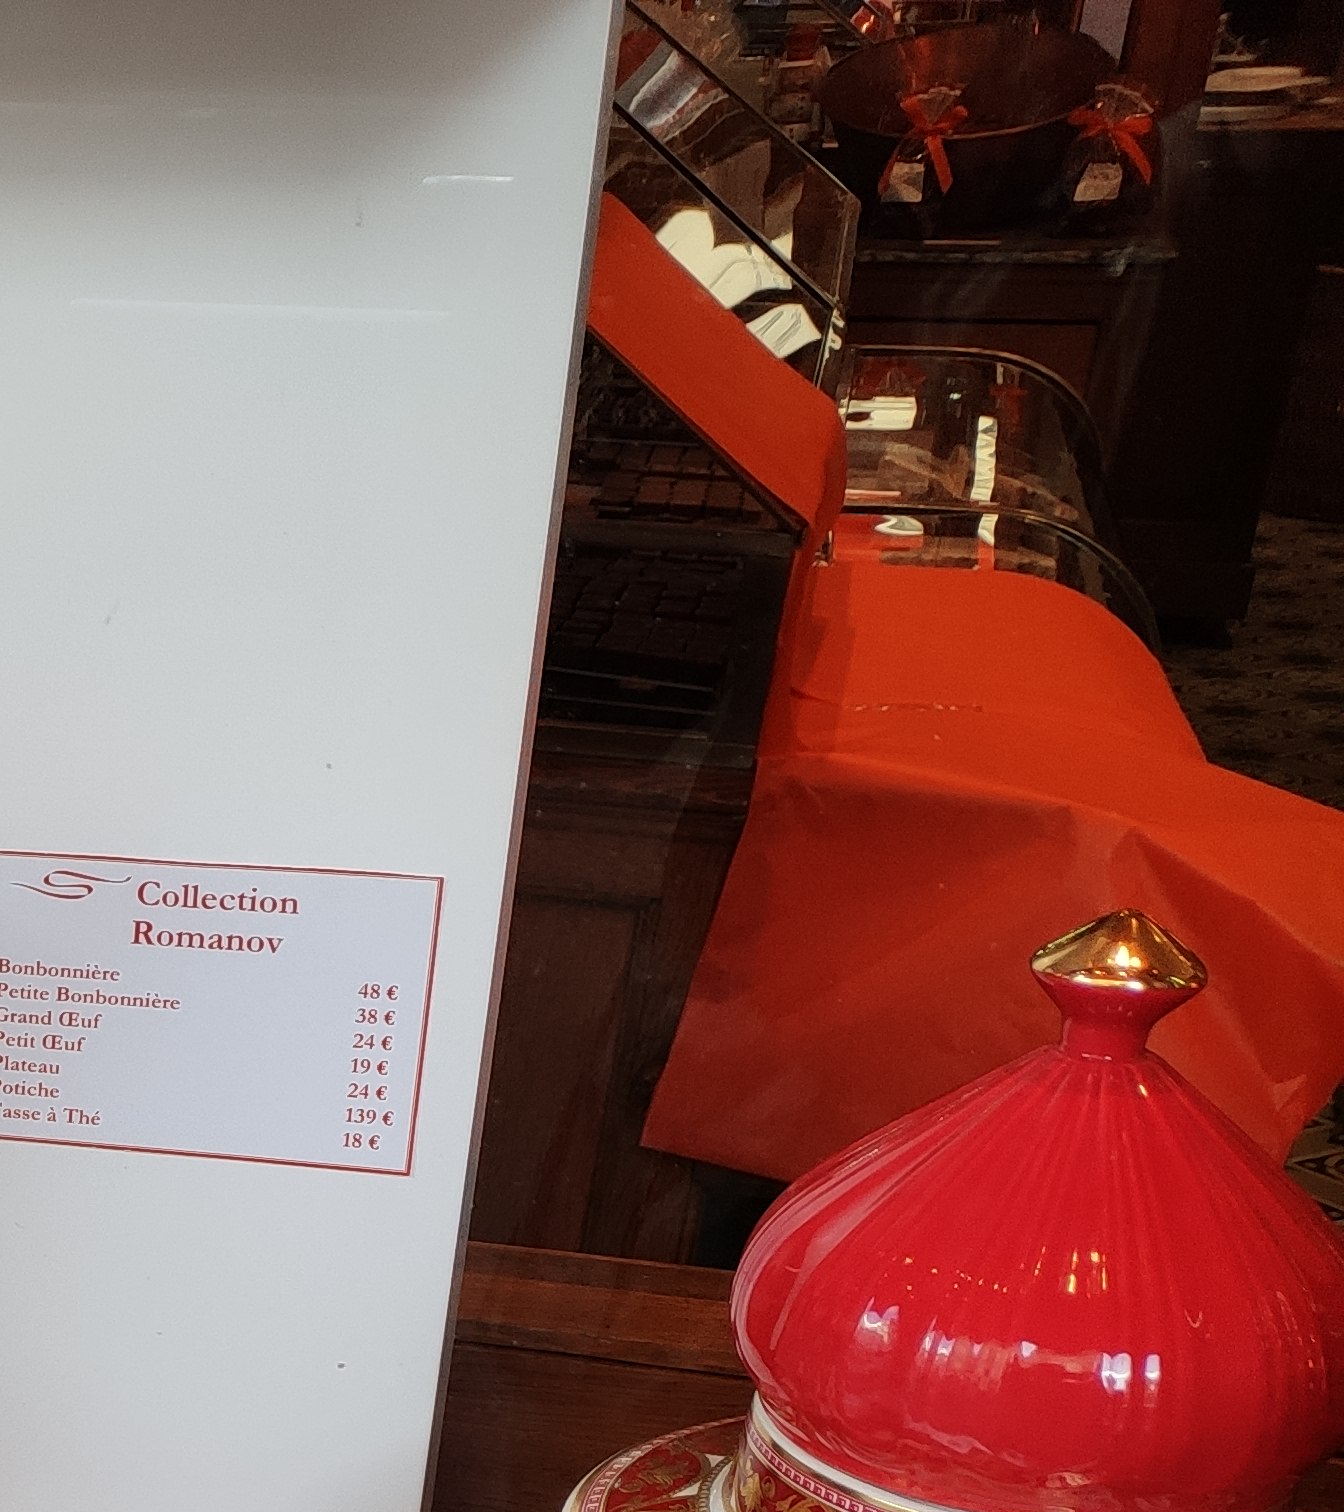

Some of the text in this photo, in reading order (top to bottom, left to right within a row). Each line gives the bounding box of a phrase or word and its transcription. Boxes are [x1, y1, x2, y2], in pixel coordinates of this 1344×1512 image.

[137, 881, 300, 915] Collection
[130, 919, 284, 954] Romanov
[56, 986, 181, 1010] Bonbonnière
[354, 1008, 378, 1025] 38
[383, 1010, 396, 1026] €
[357, 983, 381, 1000] 48
[386, 985, 399, 1001] €
[59, 1011, 103, 1029] Œuf
[352, 1033, 376, 1050] 24
[381, 1035, 393, 1051] €
[42, 1034, 86, 1052] Œuf
[351, 1058, 371, 1074] 19
[376, 1060, 389, 1076] €
[346, 1083, 369, 1099] 24
[375, 1085, 388, 1101] €
[46, 1106, 57, 1122] à
[63, 1108, 101, 1126] Thé
[342, 1132, 363, 1149] 18
[368, 1134, 381, 1150] €
[345, 1107, 377, 1124] 139
[381, 1111, 395, 1126] €
